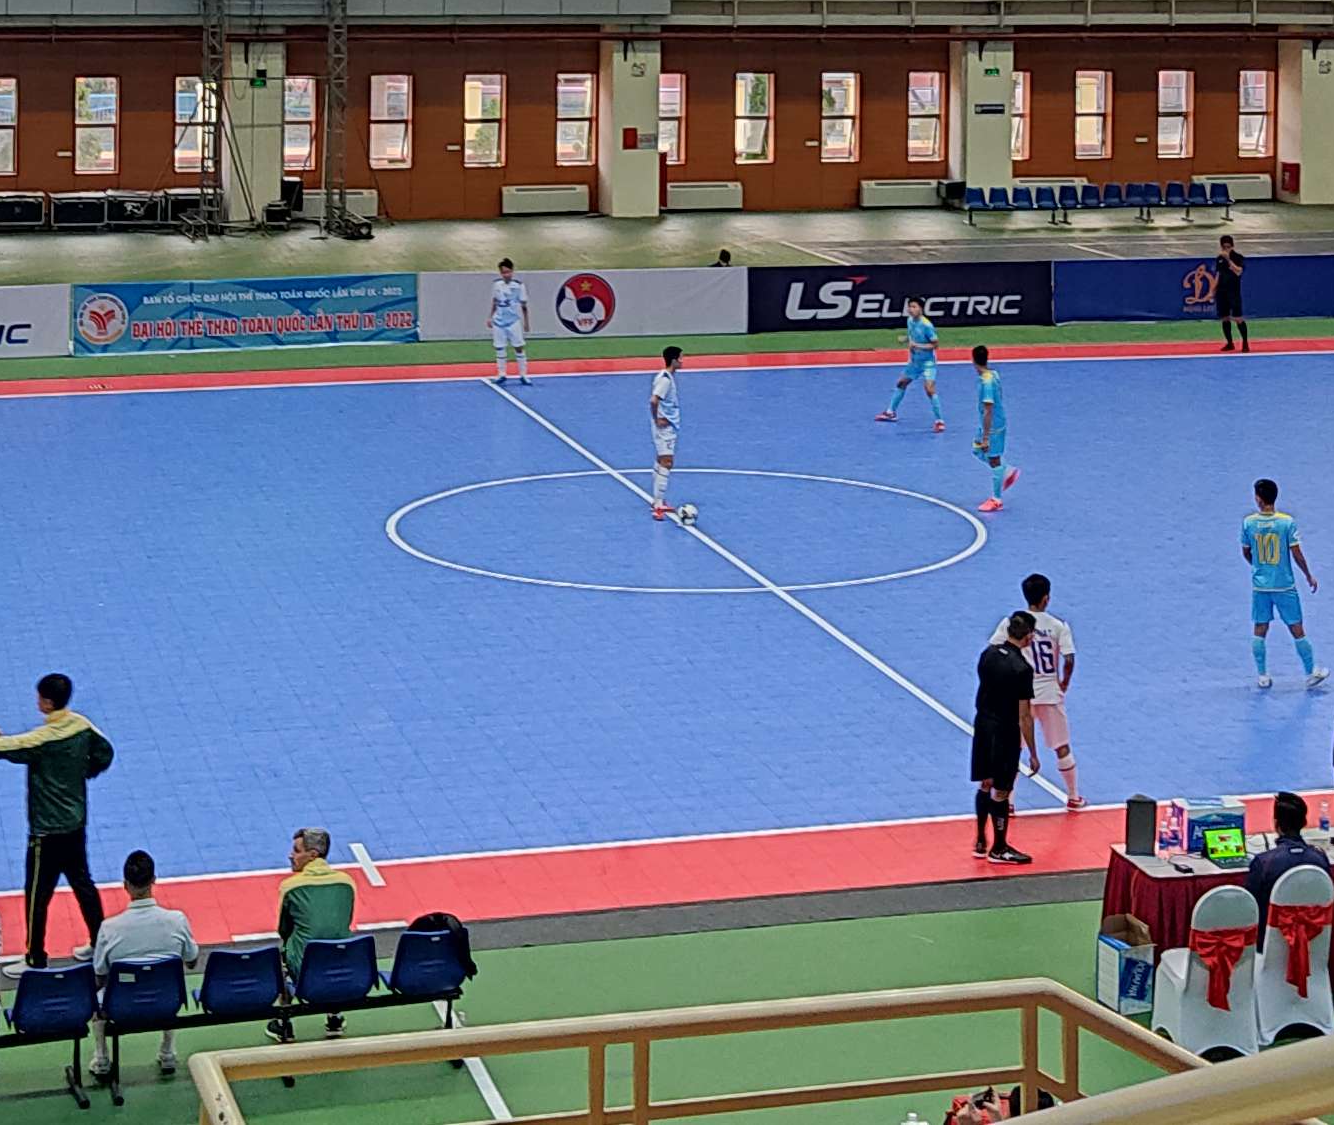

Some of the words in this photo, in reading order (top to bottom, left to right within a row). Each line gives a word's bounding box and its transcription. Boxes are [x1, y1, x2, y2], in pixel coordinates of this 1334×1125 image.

[784, 281, 854, 321] LS
[180, 310, 205, 339] THỂ
[207, 318, 240, 339] THAO
[240, 312, 274, 335] TOÀN
[275, 309, 307, 336] QUỐC
[1254, 532, 1280, 565] 10
[1030, 640, 1056, 675] 16
